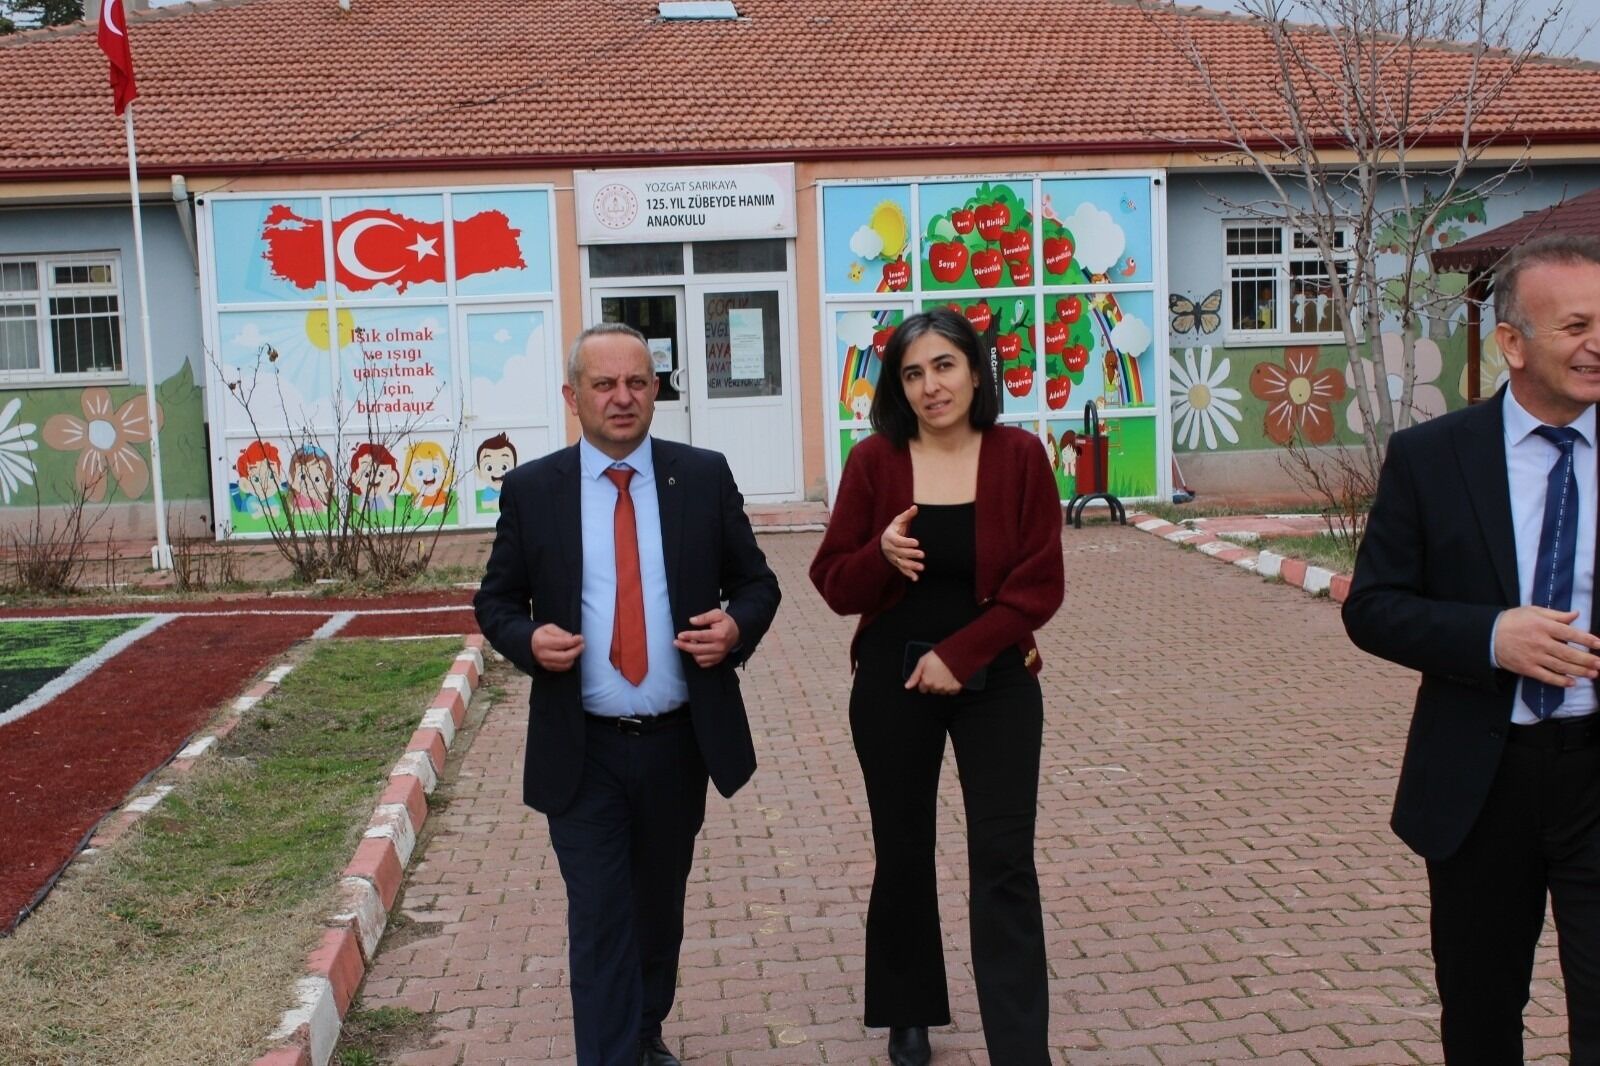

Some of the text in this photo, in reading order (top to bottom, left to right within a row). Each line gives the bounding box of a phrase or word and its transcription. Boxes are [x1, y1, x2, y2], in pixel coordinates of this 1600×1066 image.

[645, 180, 737, 192] YOZGAT SARIKAYA
[646, 194, 775, 210] 125. YIL ZÜBEYDE HANIM
[647, 213, 706, 227] ANAOKULU
[938, 259, 957, 269] Saygı
[974, 263, 1001, 276] Dürüstlük
[385, 327, 433, 342] olmak
[363, 350, 382, 360] ve
[353, 362, 434, 381] yansıtmak
[1007, 379, 1032, 389] Özgüven
[1049, 389, 1067, 400] Adalet
[357, 399, 434, 415] buradayız
